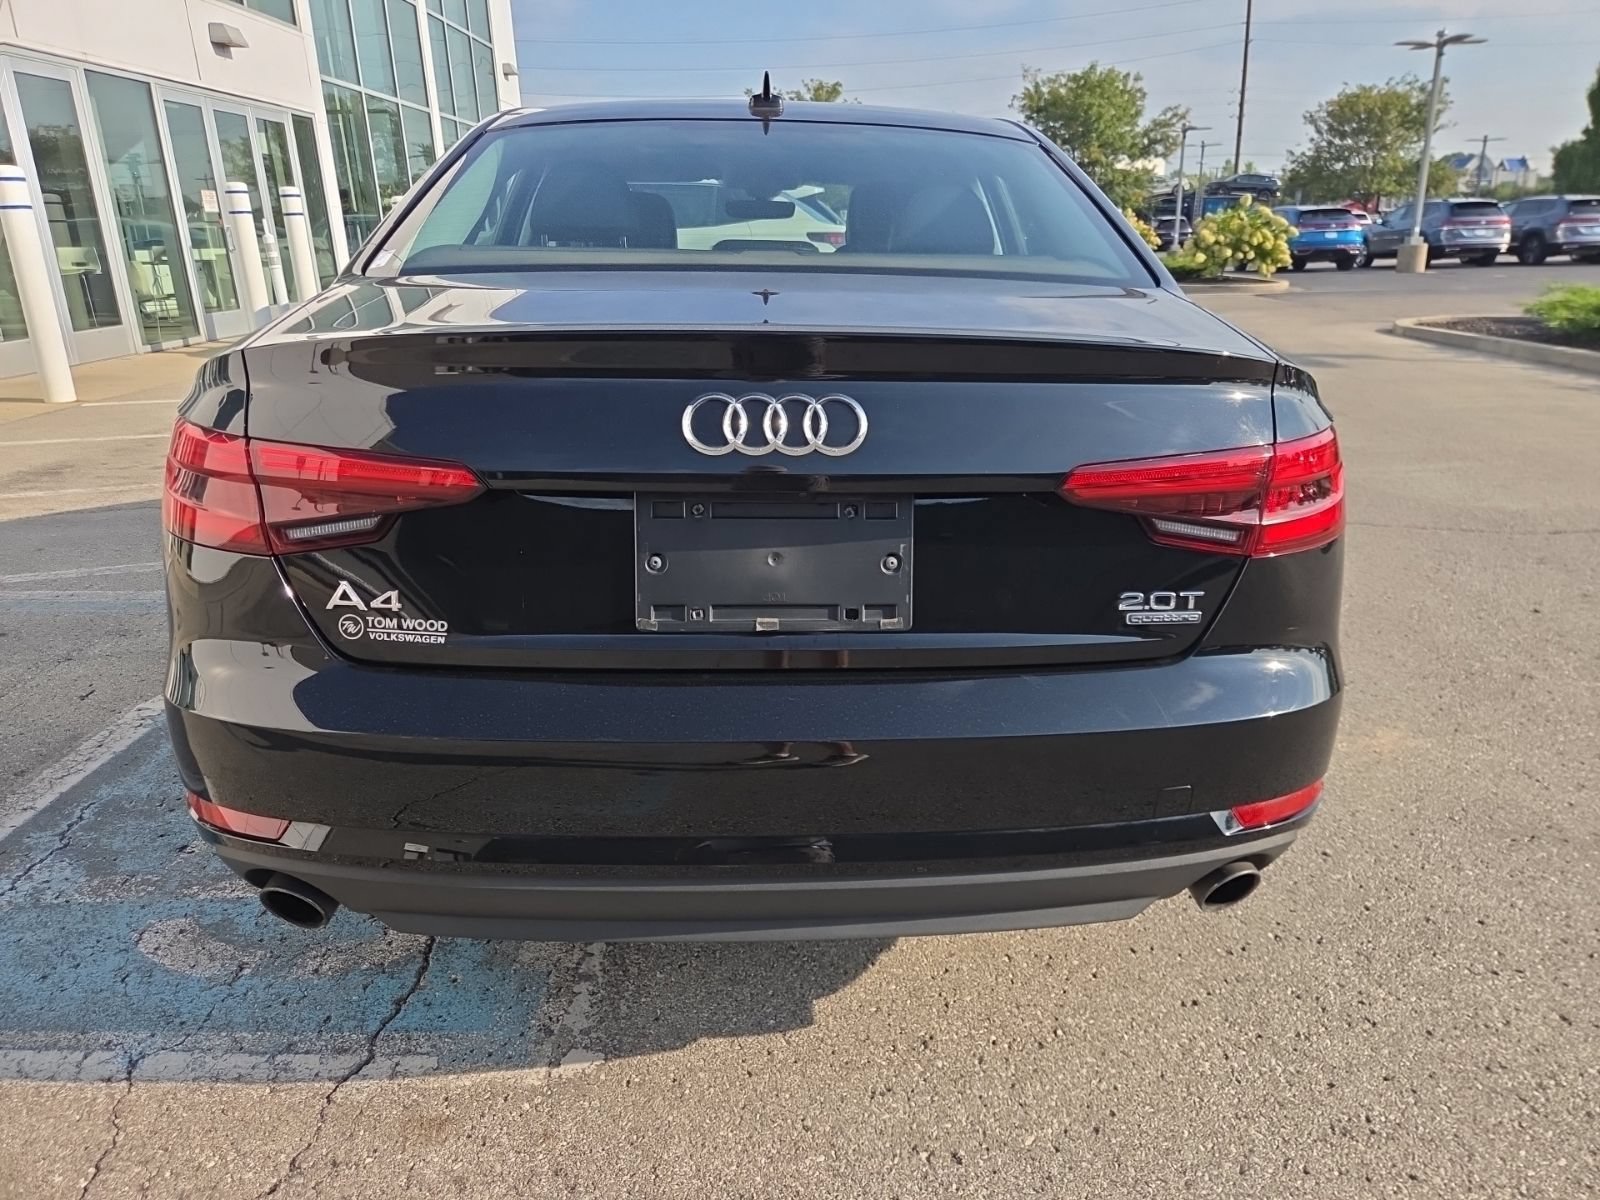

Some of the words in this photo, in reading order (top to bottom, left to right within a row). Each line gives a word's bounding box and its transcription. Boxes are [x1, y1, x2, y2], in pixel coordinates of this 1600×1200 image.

[325, 580, 402, 612] A4
[1118, 591, 1205, 611] 2.0T
[366, 616, 398, 629] TOM
[401, 619, 448, 631] WOOD
[1130, 613, 1200, 624] quattro
[368, 632, 446, 644] VOLKSWAGEN
